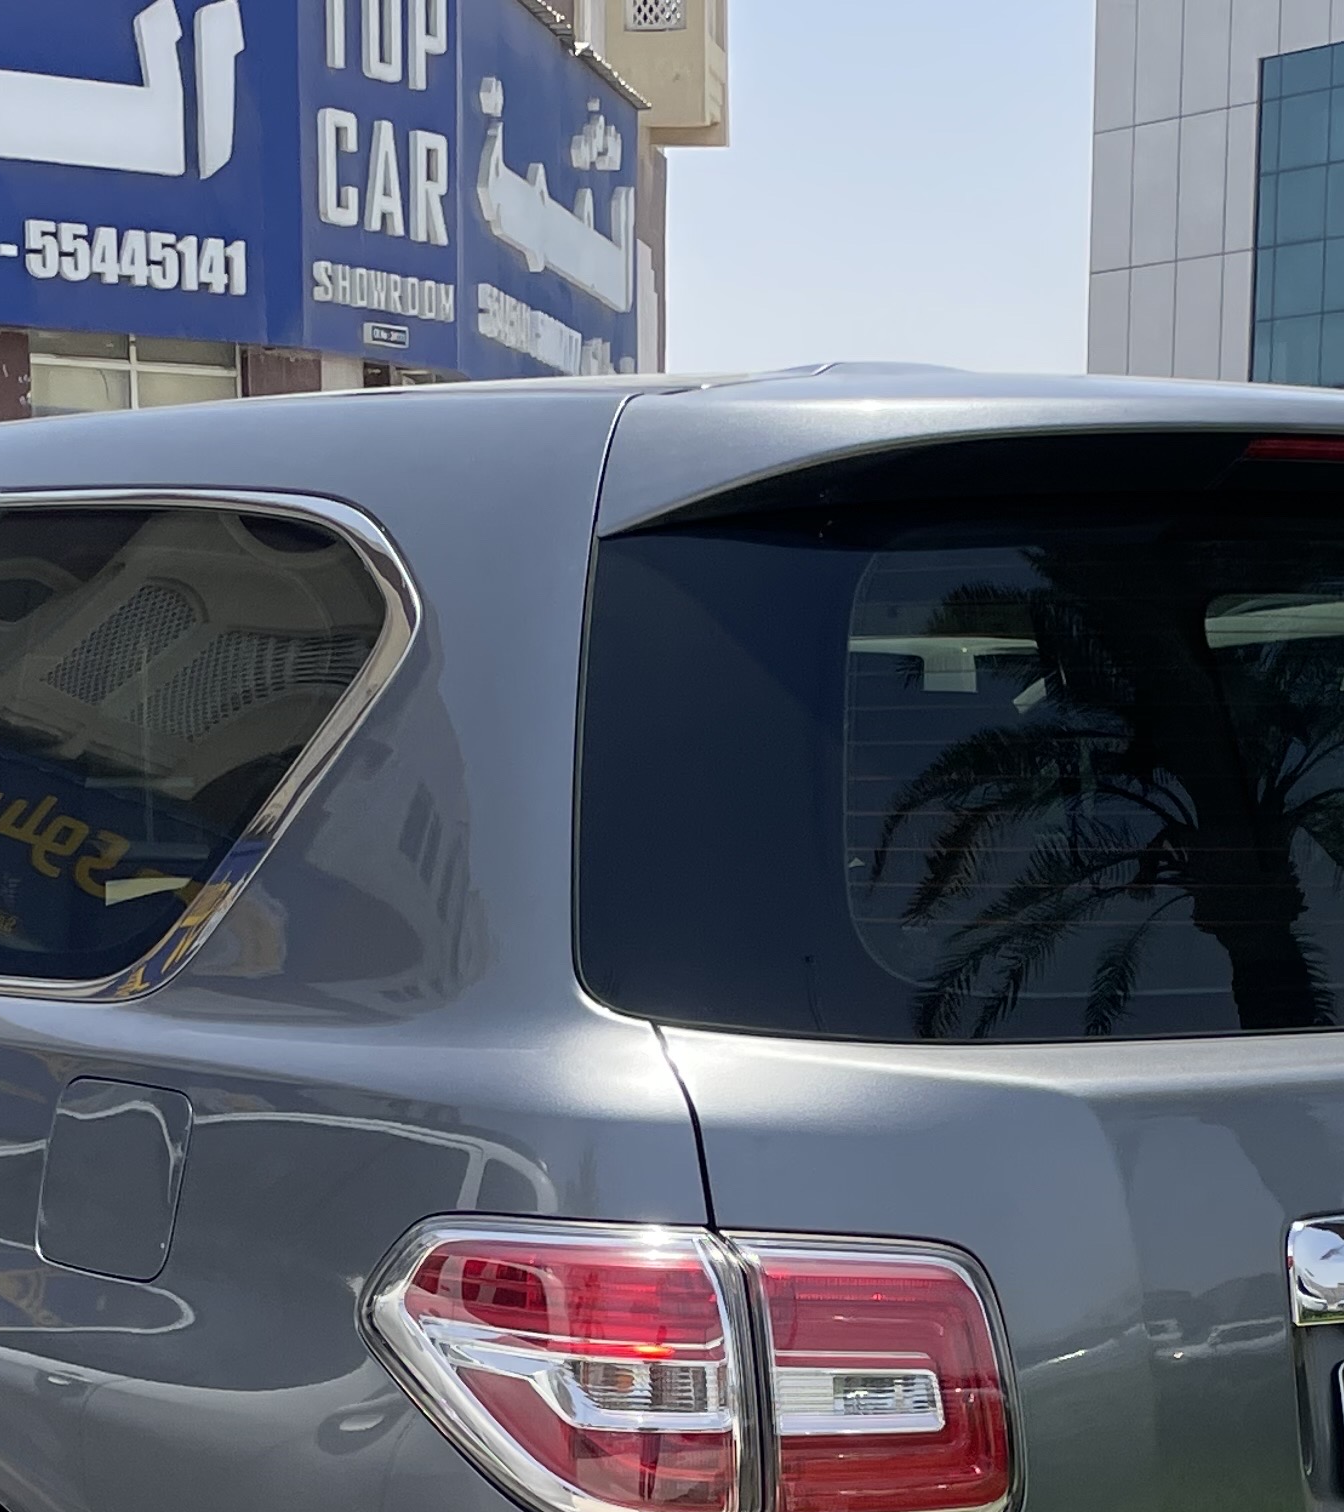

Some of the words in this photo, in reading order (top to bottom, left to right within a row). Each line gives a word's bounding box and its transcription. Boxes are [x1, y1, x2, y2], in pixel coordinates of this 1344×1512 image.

[317, 107, 450, 247] CAR
[24, 218, 248, 296] 55445141
[312, 261, 455, 323] SHOWROOM
